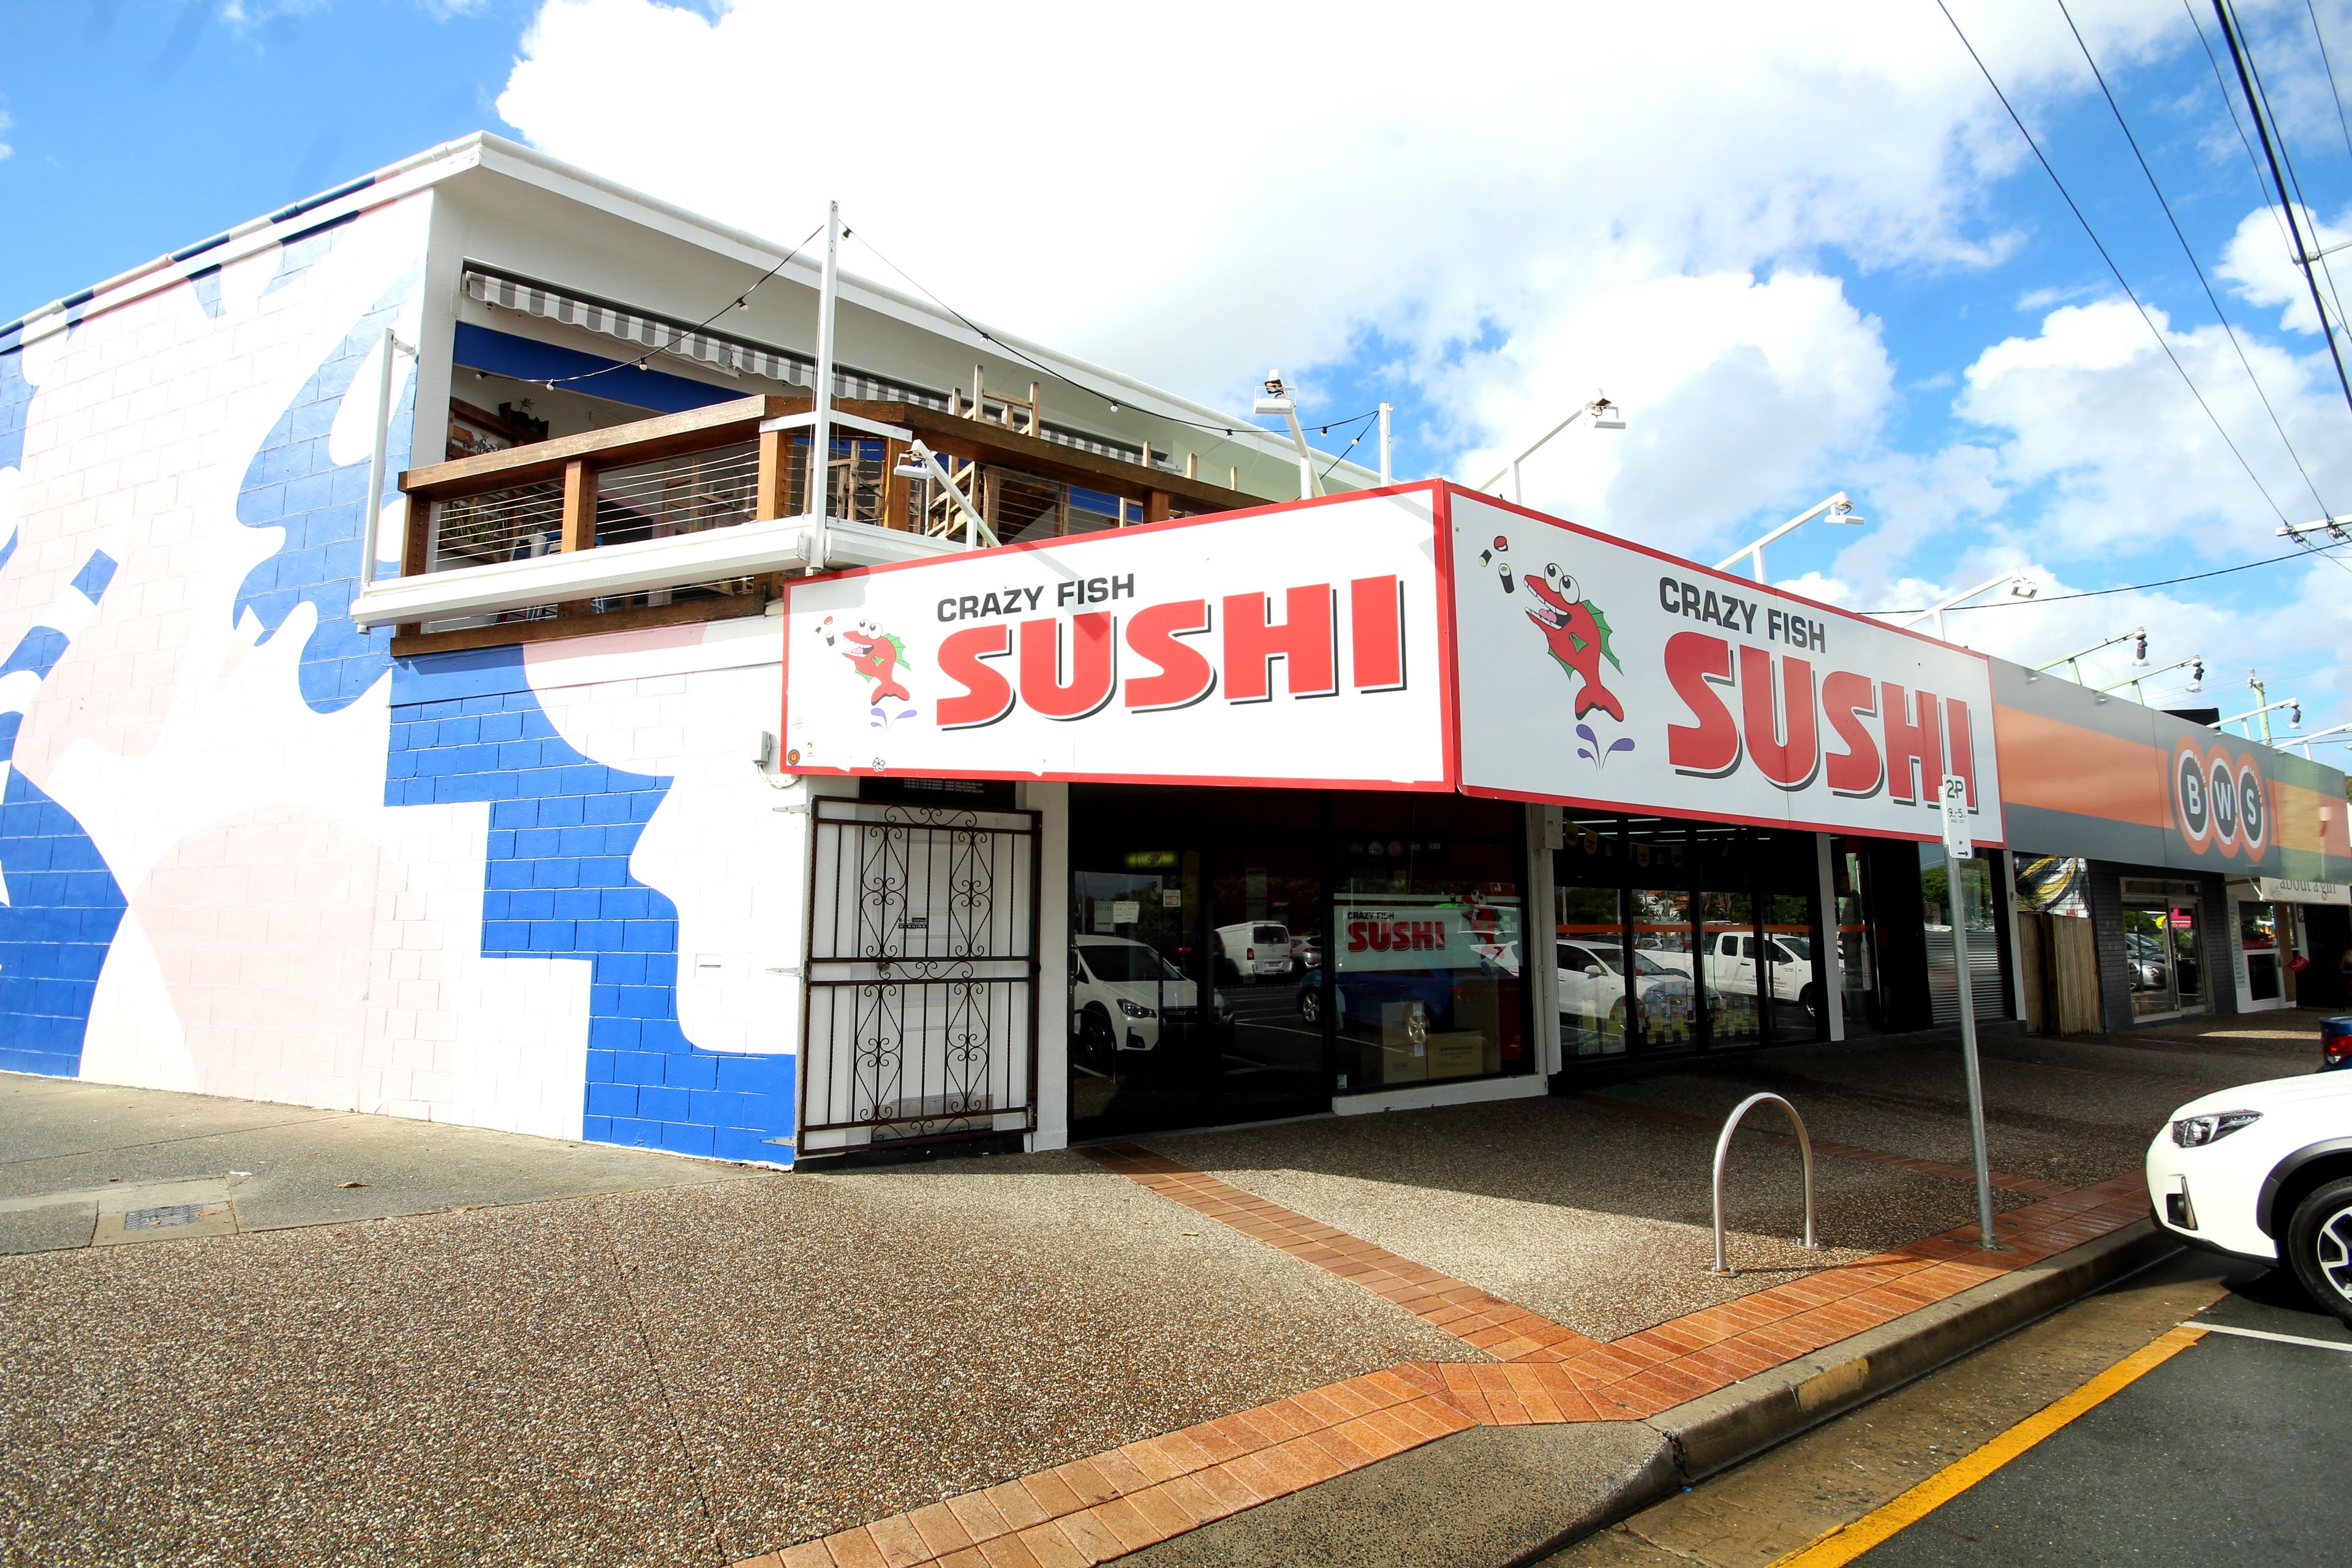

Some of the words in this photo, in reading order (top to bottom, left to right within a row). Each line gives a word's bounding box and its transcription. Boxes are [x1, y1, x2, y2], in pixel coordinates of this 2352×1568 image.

[937, 585, 1044, 623] CRAZY
[1057, 573, 1135, 609] FISH
[1659, 576, 1757, 635] CRAZY
[1768, 608, 1826, 654] FISH
[936, 574, 1407, 731] SUSHI
[1664, 631, 1979, 815] SUSHI
[1946, 779, 1963, 799] 2P
[1348, 921, 1445, 952] SUSHI
